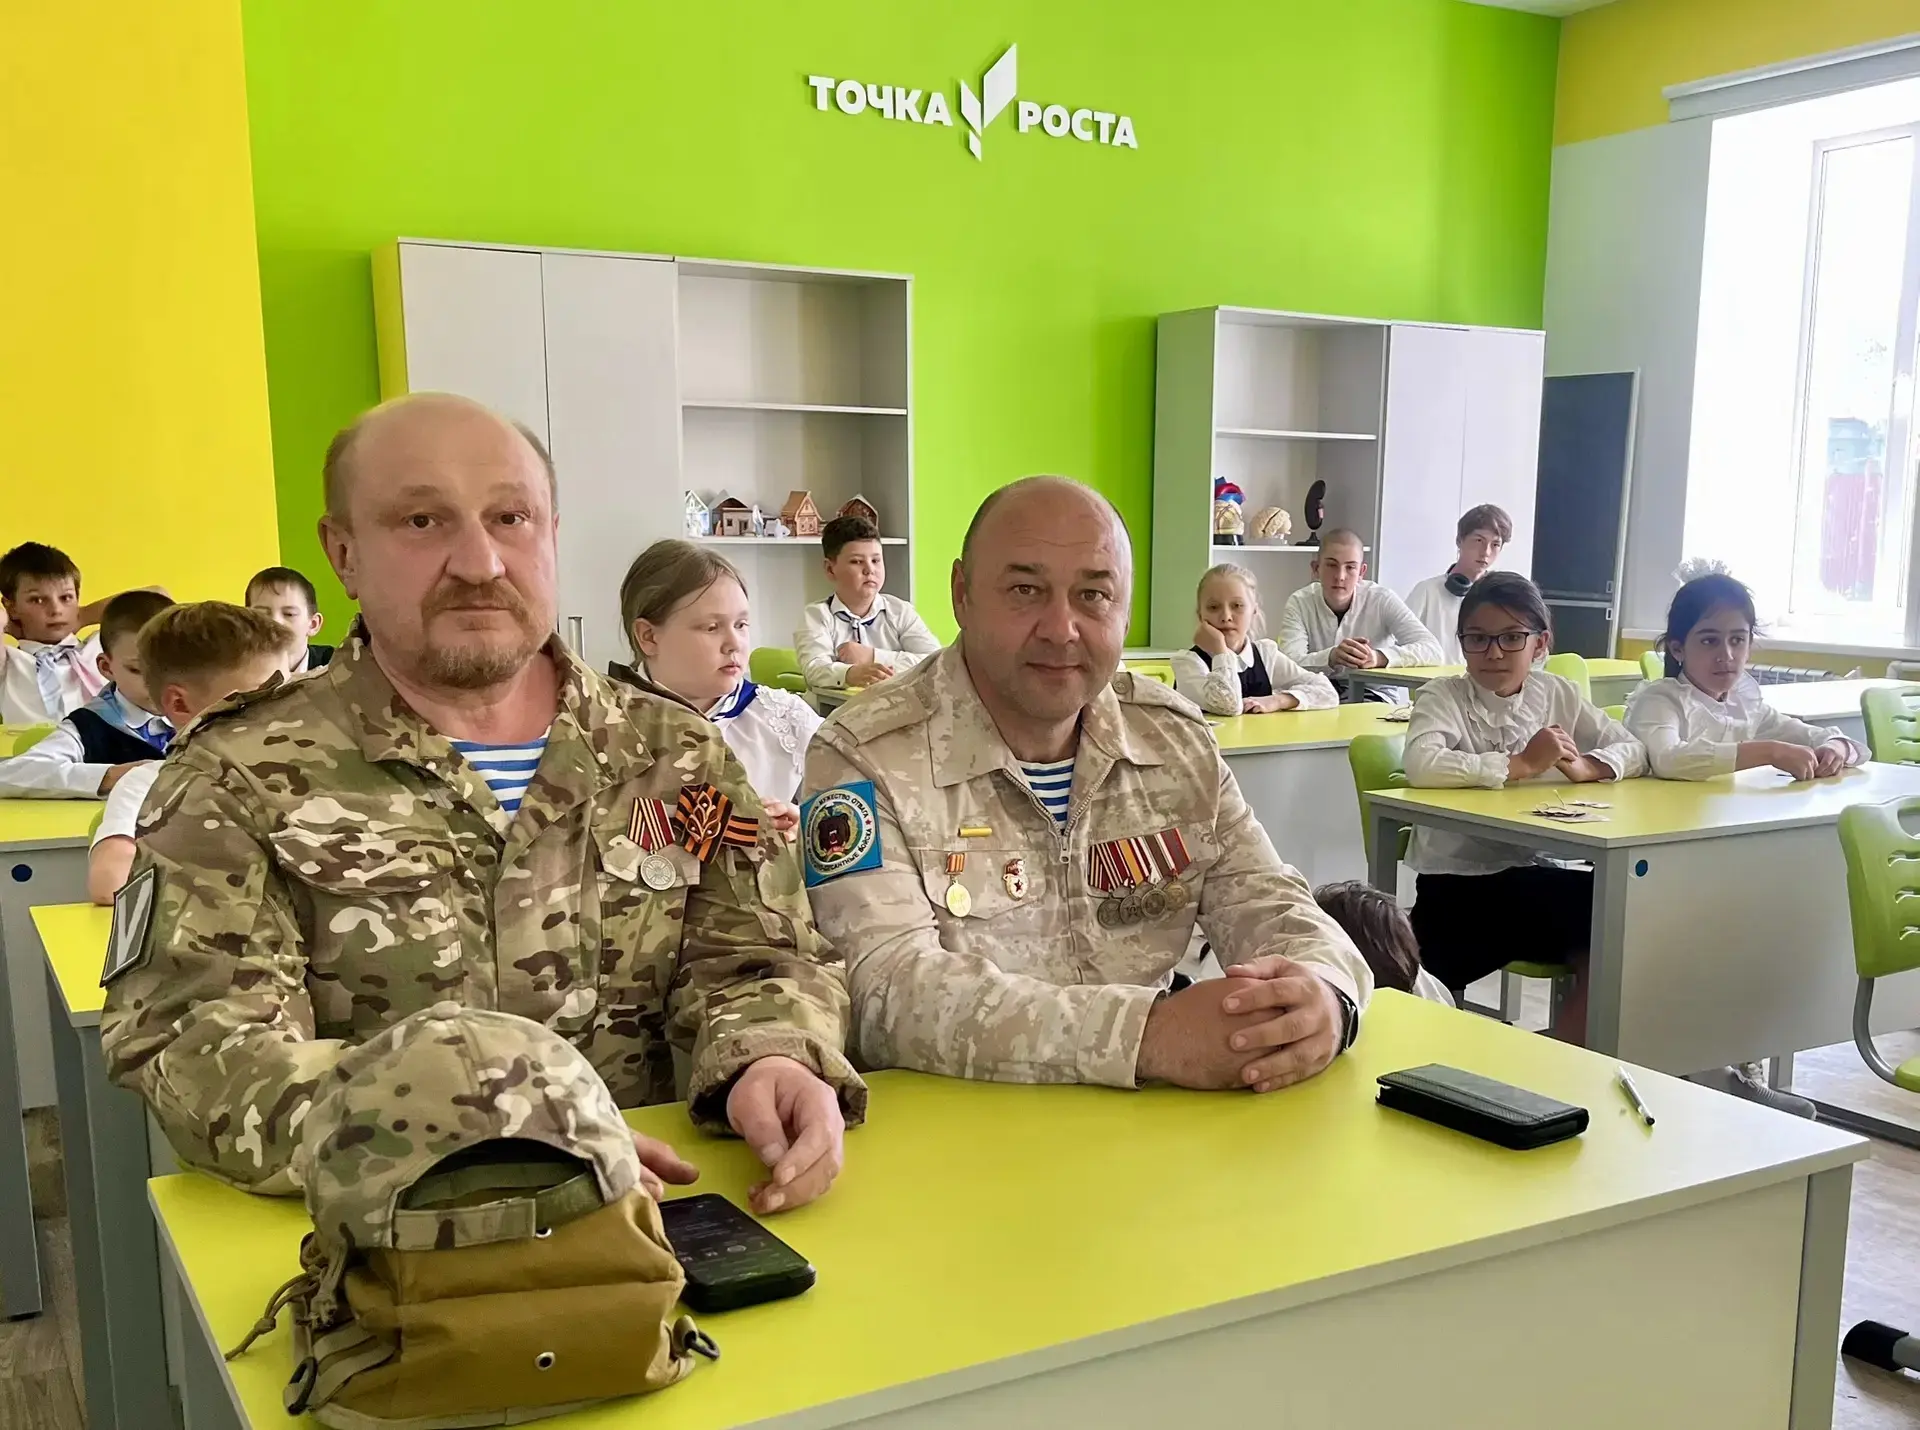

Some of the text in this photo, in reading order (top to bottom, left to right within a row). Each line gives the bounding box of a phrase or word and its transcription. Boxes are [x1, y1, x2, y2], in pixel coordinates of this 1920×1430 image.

[808, 74, 1139, 149] ТОЧКА РОСТА
[851, 798, 869, 818] ОТВАГА
